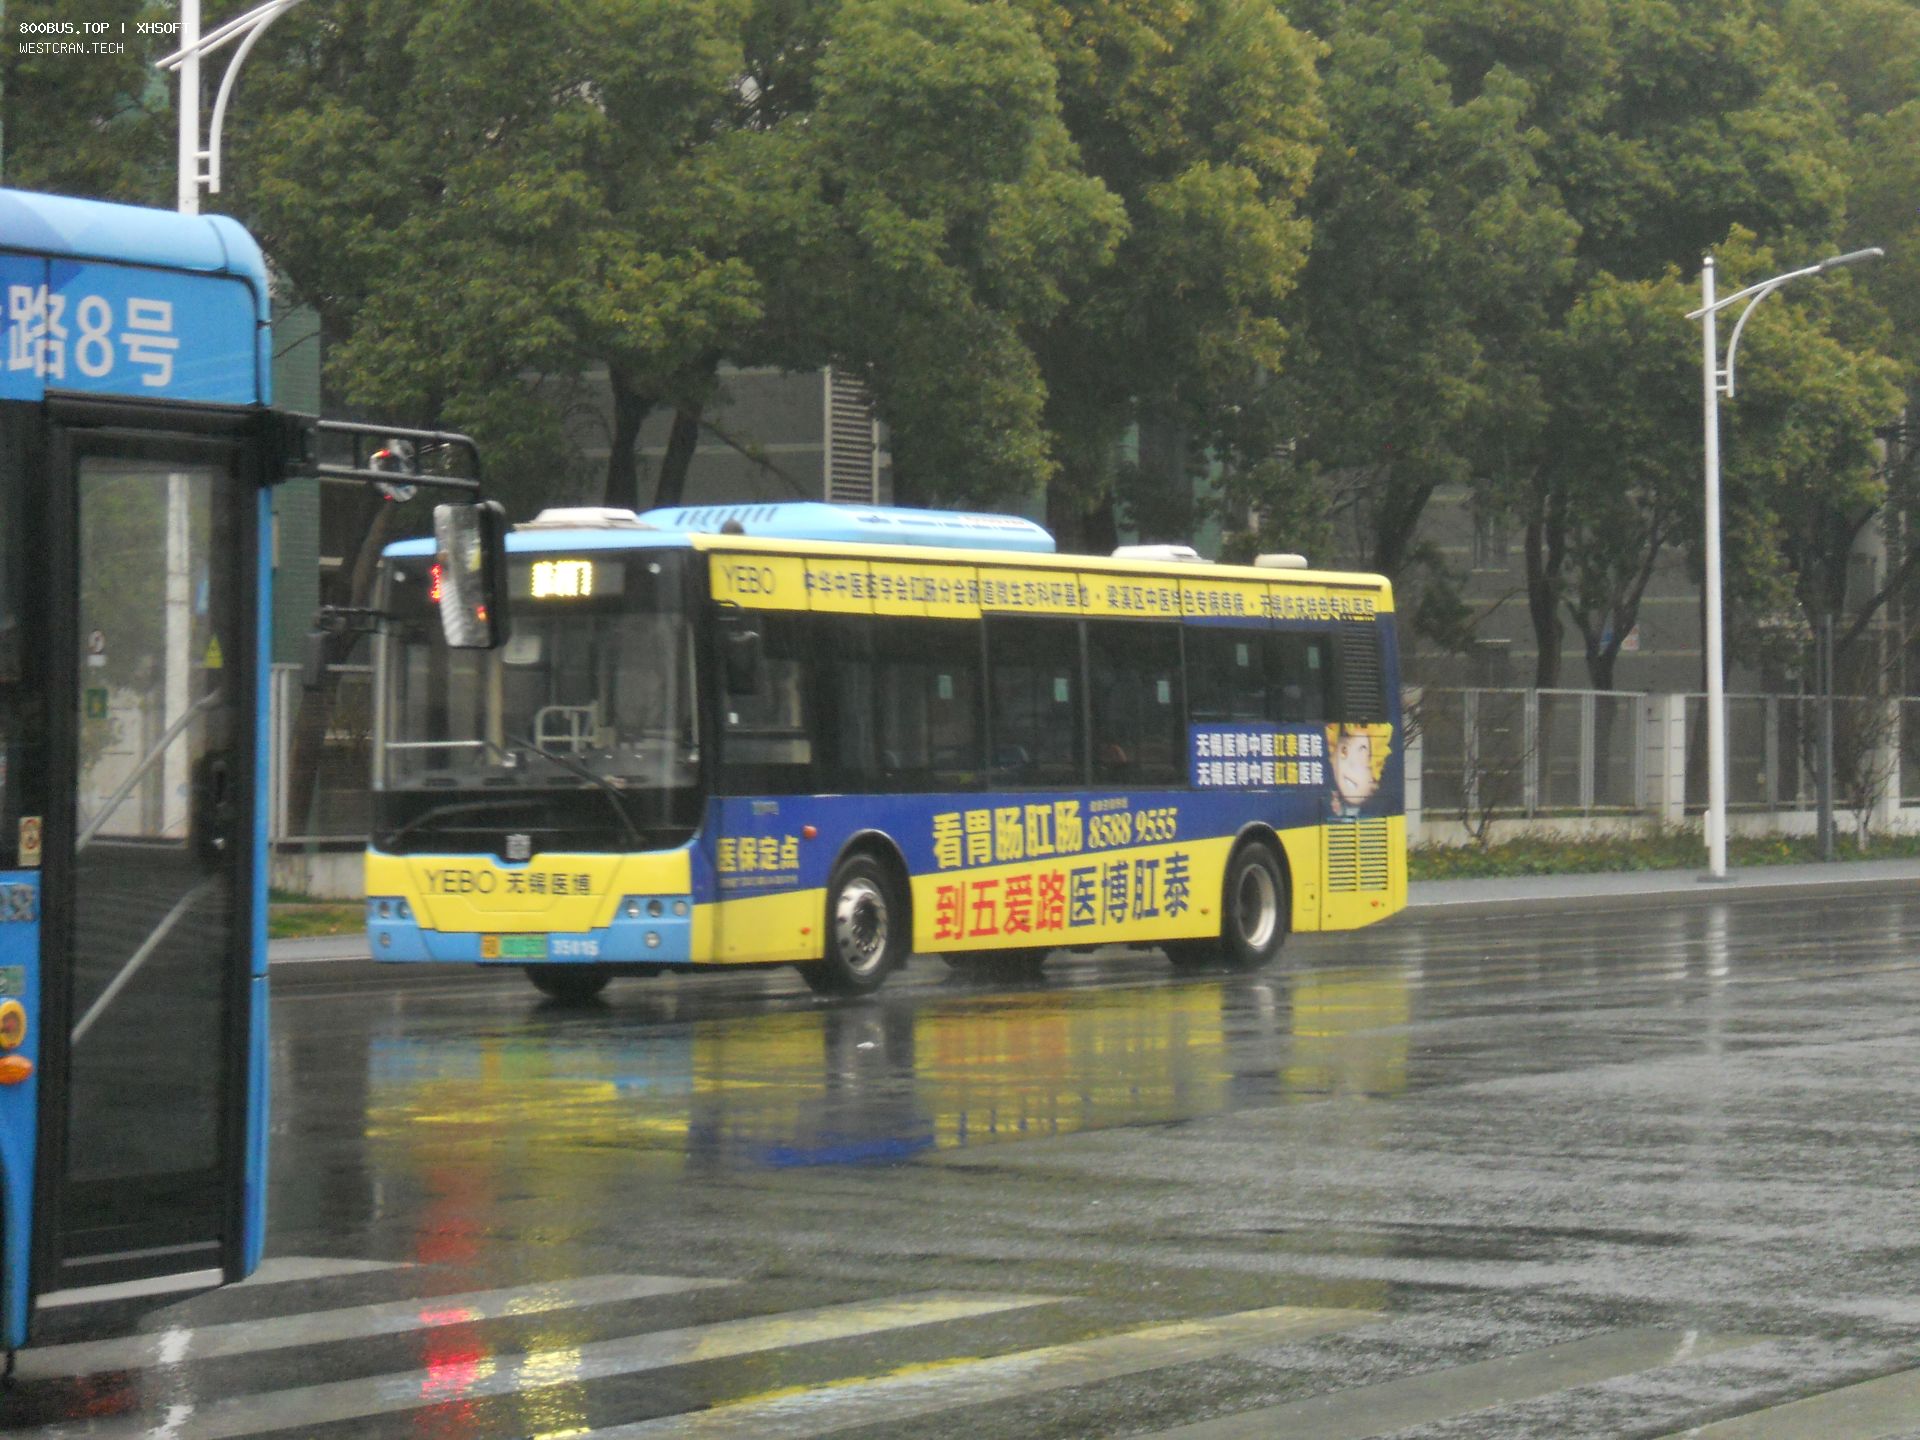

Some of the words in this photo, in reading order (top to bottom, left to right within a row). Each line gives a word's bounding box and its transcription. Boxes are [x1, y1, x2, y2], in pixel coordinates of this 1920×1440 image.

[0, 284, 181, 388] 路8号
[721, 564, 777, 595] YEBO
[717, 834, 799, 871] 医保定点
[932, 800, 1083, 869] 看胃肠肛肠
[1087, 813, 1131, 848] 8588
[1135, 806, 1178, 843] 9555
[424, 869, 496, 895] YEBO
[506, 872, 592, 896] 无锡医博
